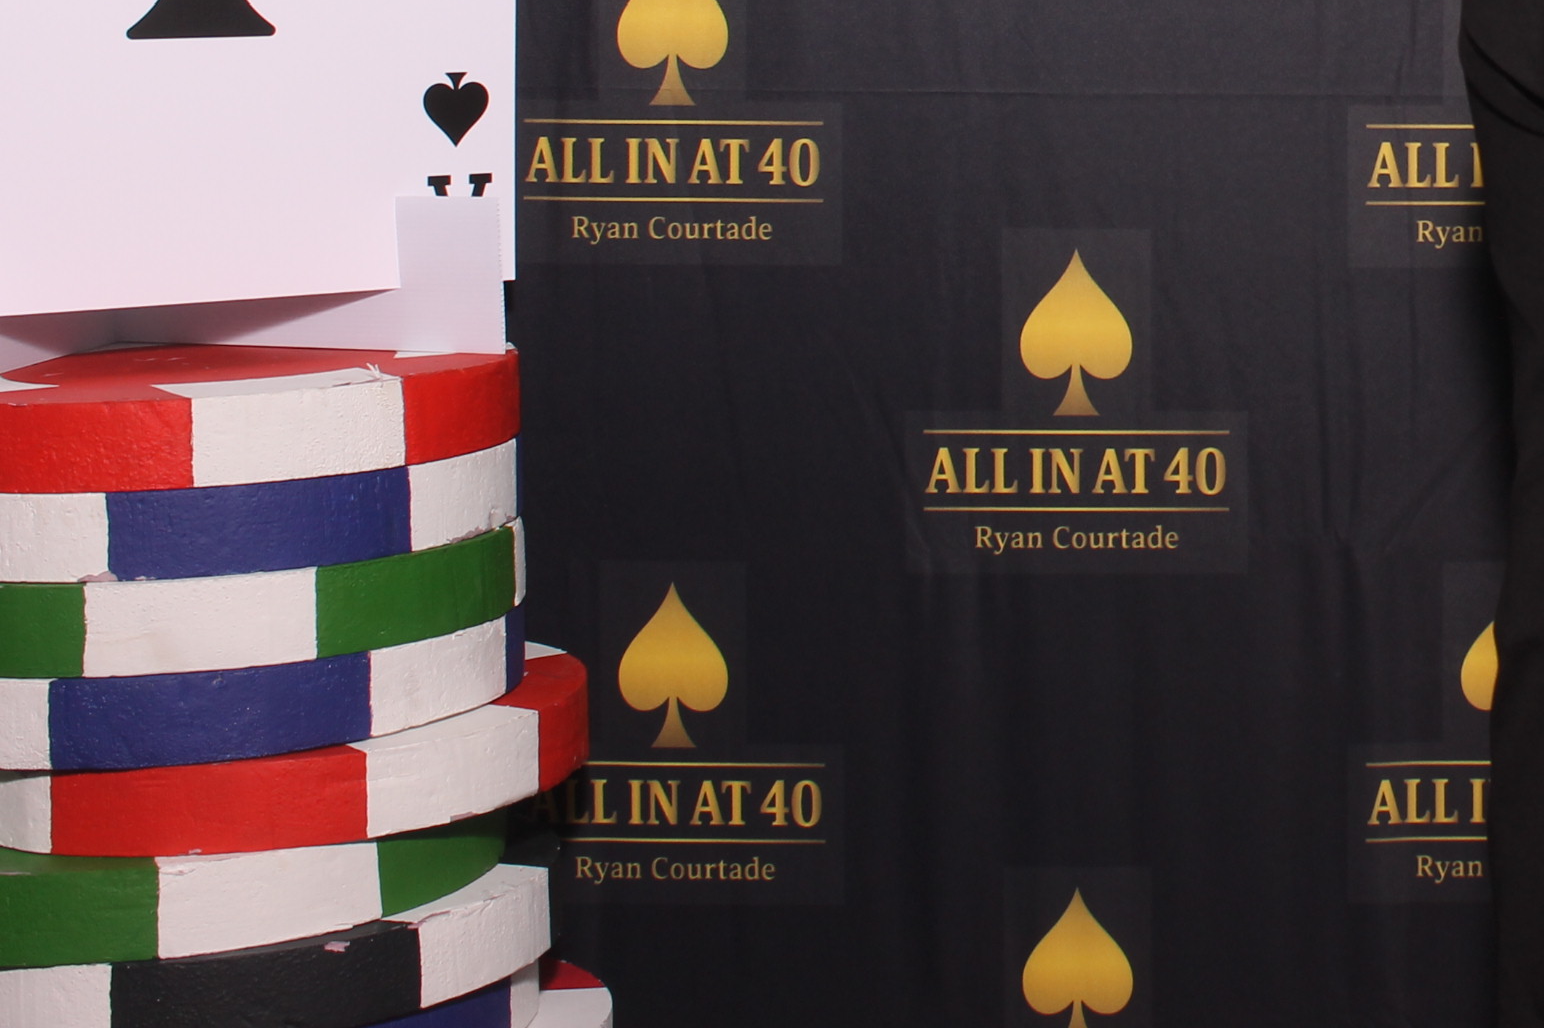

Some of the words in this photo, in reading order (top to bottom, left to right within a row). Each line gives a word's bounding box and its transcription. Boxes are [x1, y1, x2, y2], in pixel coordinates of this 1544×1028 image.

[525, 136, 614, 184] ALL
[625, 137, 679, 184] IN
[687, 138, 749, 185] AT
[757, 137, 820, 187] 40
[1367, 141, 1459, 189] ALL
[1469, 142, 1485, 188] I
[571, 215, 639, 245] Ryan
[647, 215, 773, 241] Courtade
[1416, 219, 1484, 249] Ryan
[925, 447, 1018, 494] ALL
[1029, 447, 1083, 495] IN
[1092, 448, 1155, 495] AT
[1163, 446, 1226, 496] 40
[975, 525, 1043, 556] Ryan
[1052, 524, 1179, 550] Courtade
[627, 778, 681, 827] IN
[688, 779, 752, 827] AT
[760, 778, 822, 830] 40
[1367, 778, 1458, 826] ALL
[1469, 777, 1490, 825] I
[575, 856, 642, 885] Ryan
[650, 856, 776, 882] Courtade
[1416, 854, 1483, 885] Ryan
